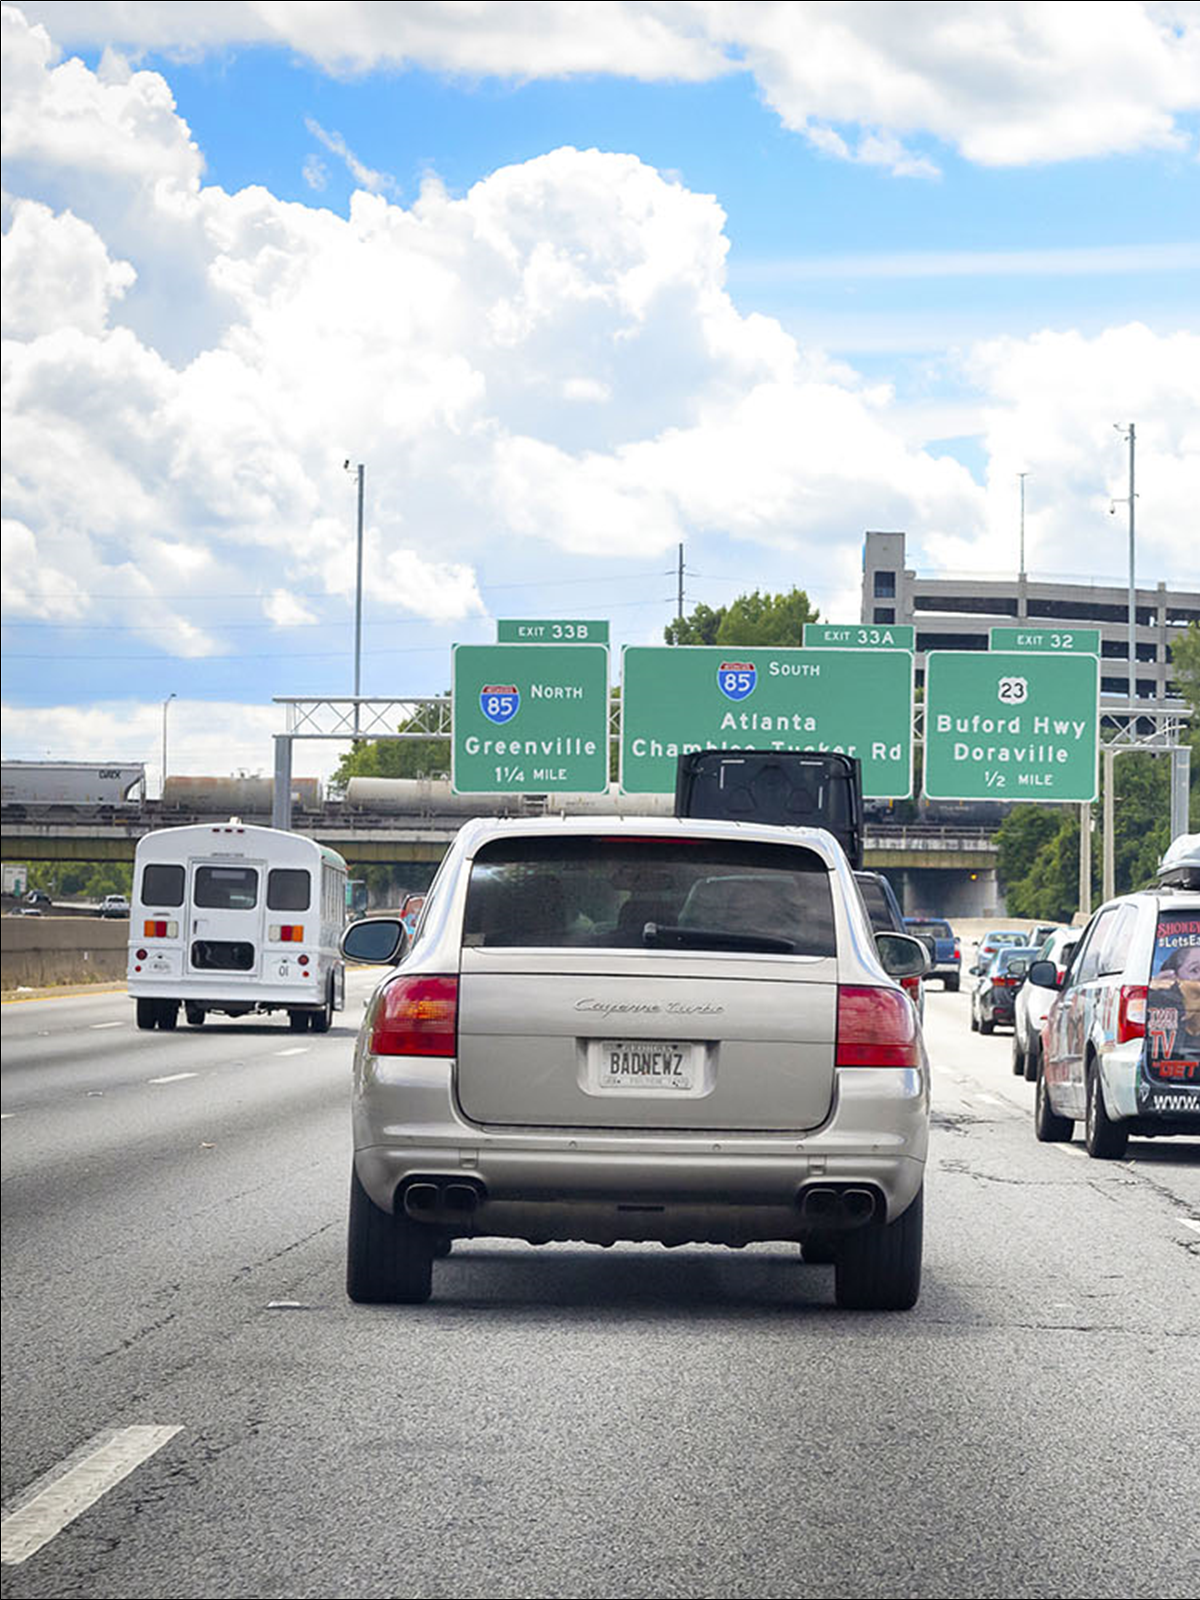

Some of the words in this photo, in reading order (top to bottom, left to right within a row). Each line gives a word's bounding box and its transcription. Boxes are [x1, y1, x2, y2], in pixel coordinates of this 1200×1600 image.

[518, 626, 545, 637] EXIT
[552, 624, 589, 639] 33B
[824, 631, 851, 641] EXIT
[857, 630, 894, 644] 33A
[1017, 635, 1043, 645] EXIT
[1050, 634, 1073, 648] 32
[769, 661, 820, 676] SOUTH
[531, 684, 583, 698] NORTH
[724, 673, 750, 691] 85
[1001, 682, 1024, 699] 23
[487, 697, 513, 715] 85
[721, 712, 816, 731] Atlanta
[937, 715, 1020, 733] Buford
[1034, 716, 1085, 739] Hwy
[465, 736, 597, 755] Greenville
[872, 742, 901, 760] Rd
[954, 743, 1068, 762] Doraville
[533, 769, 567, 780] MILE
[1018, 774, 1053, 785] MILE
[574, 998, 662, 1018] Cayenne
[665, 1001, 725, 1014] Turbo
[1150, 1029, 1176, 1059] TV
[610, 1052, 683, 1075] BADNEWZ
